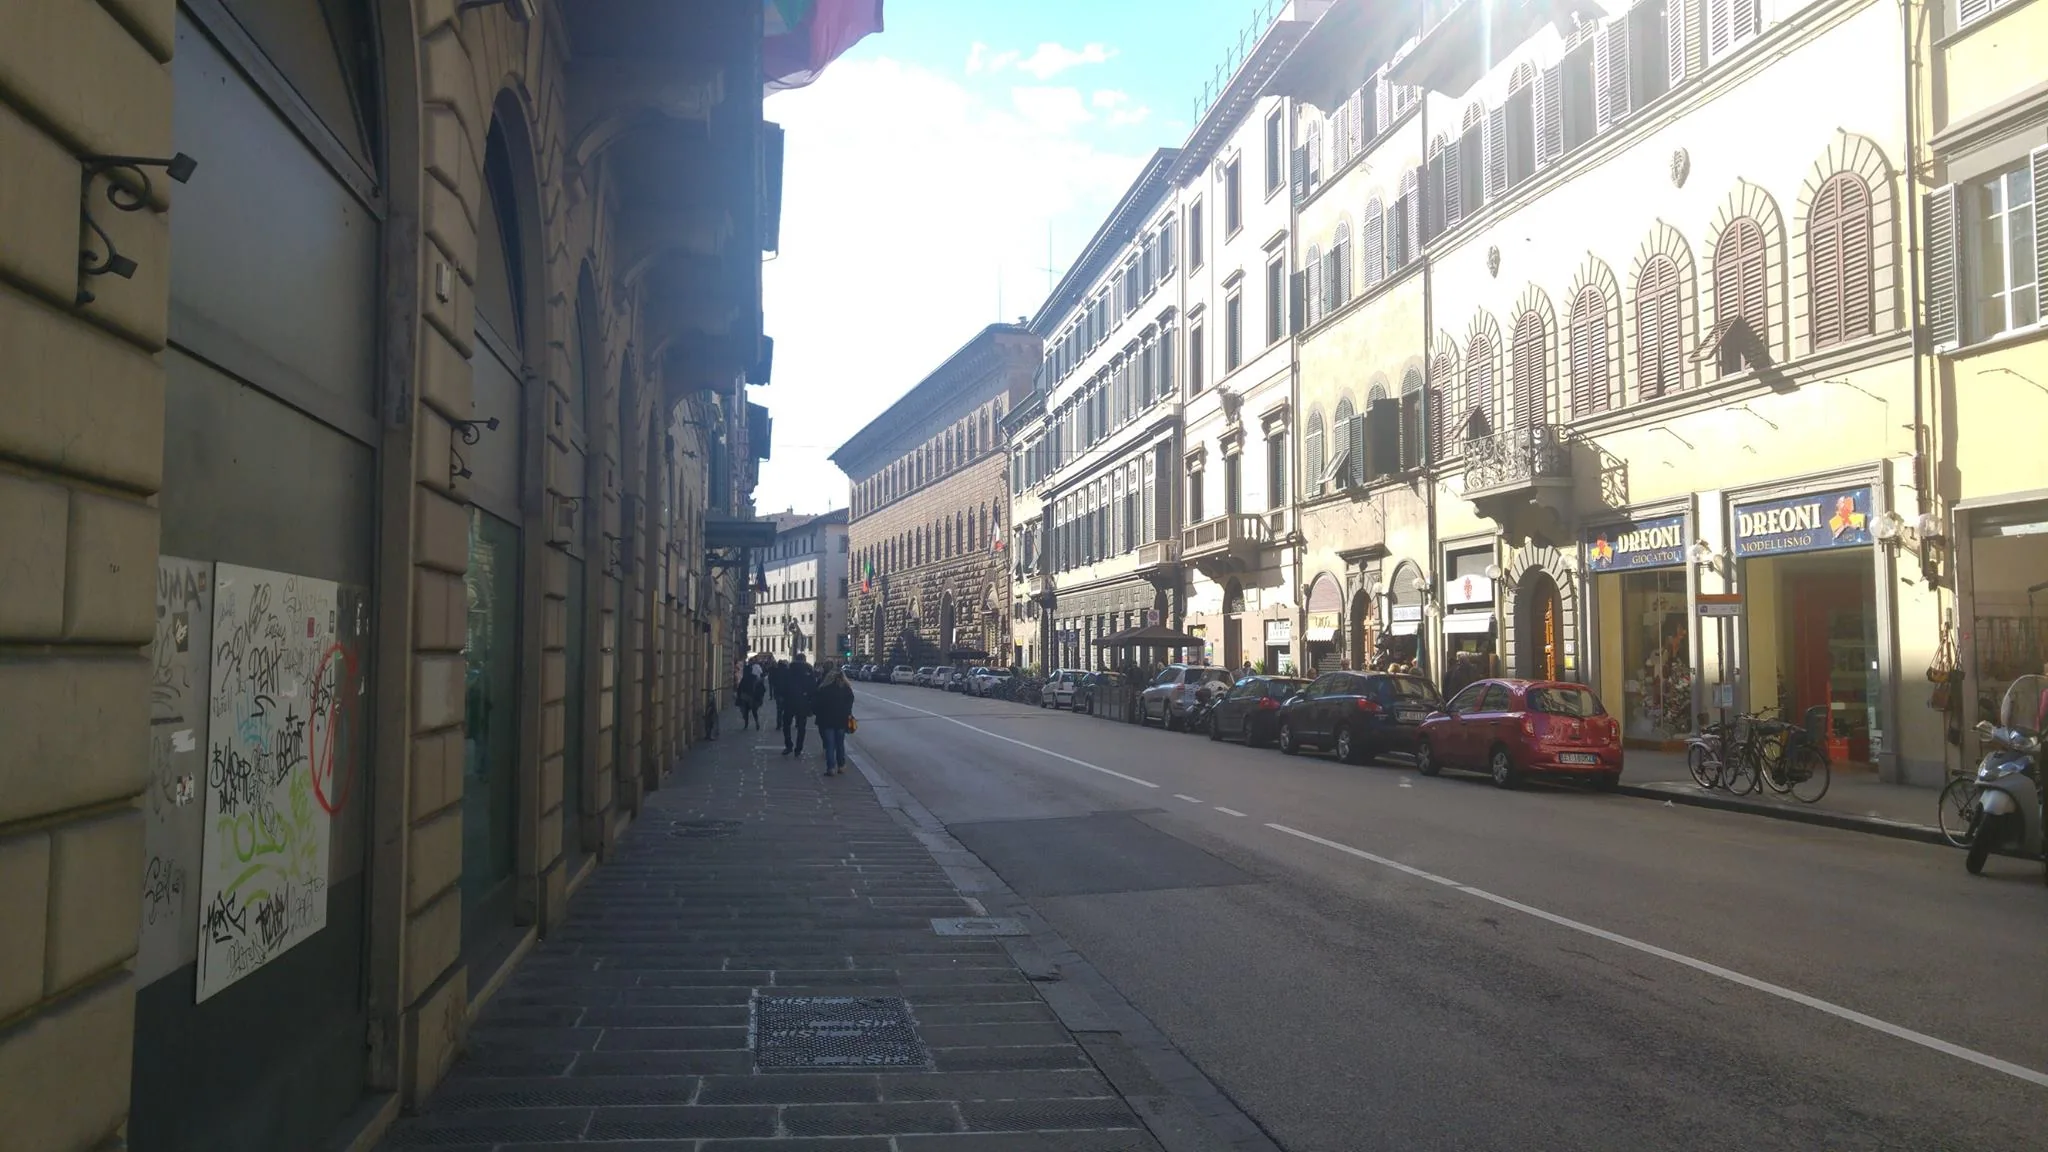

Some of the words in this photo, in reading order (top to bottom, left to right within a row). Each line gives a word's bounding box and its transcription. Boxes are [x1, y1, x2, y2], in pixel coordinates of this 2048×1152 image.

[1738, 503, 1822, 538] DREONI
[1618, 525, 1682, 553] DREONI
[1741, 535, 1812, 552] MODELLISMO
[1632, 550, 1682, 564] GIOCATTOLI
